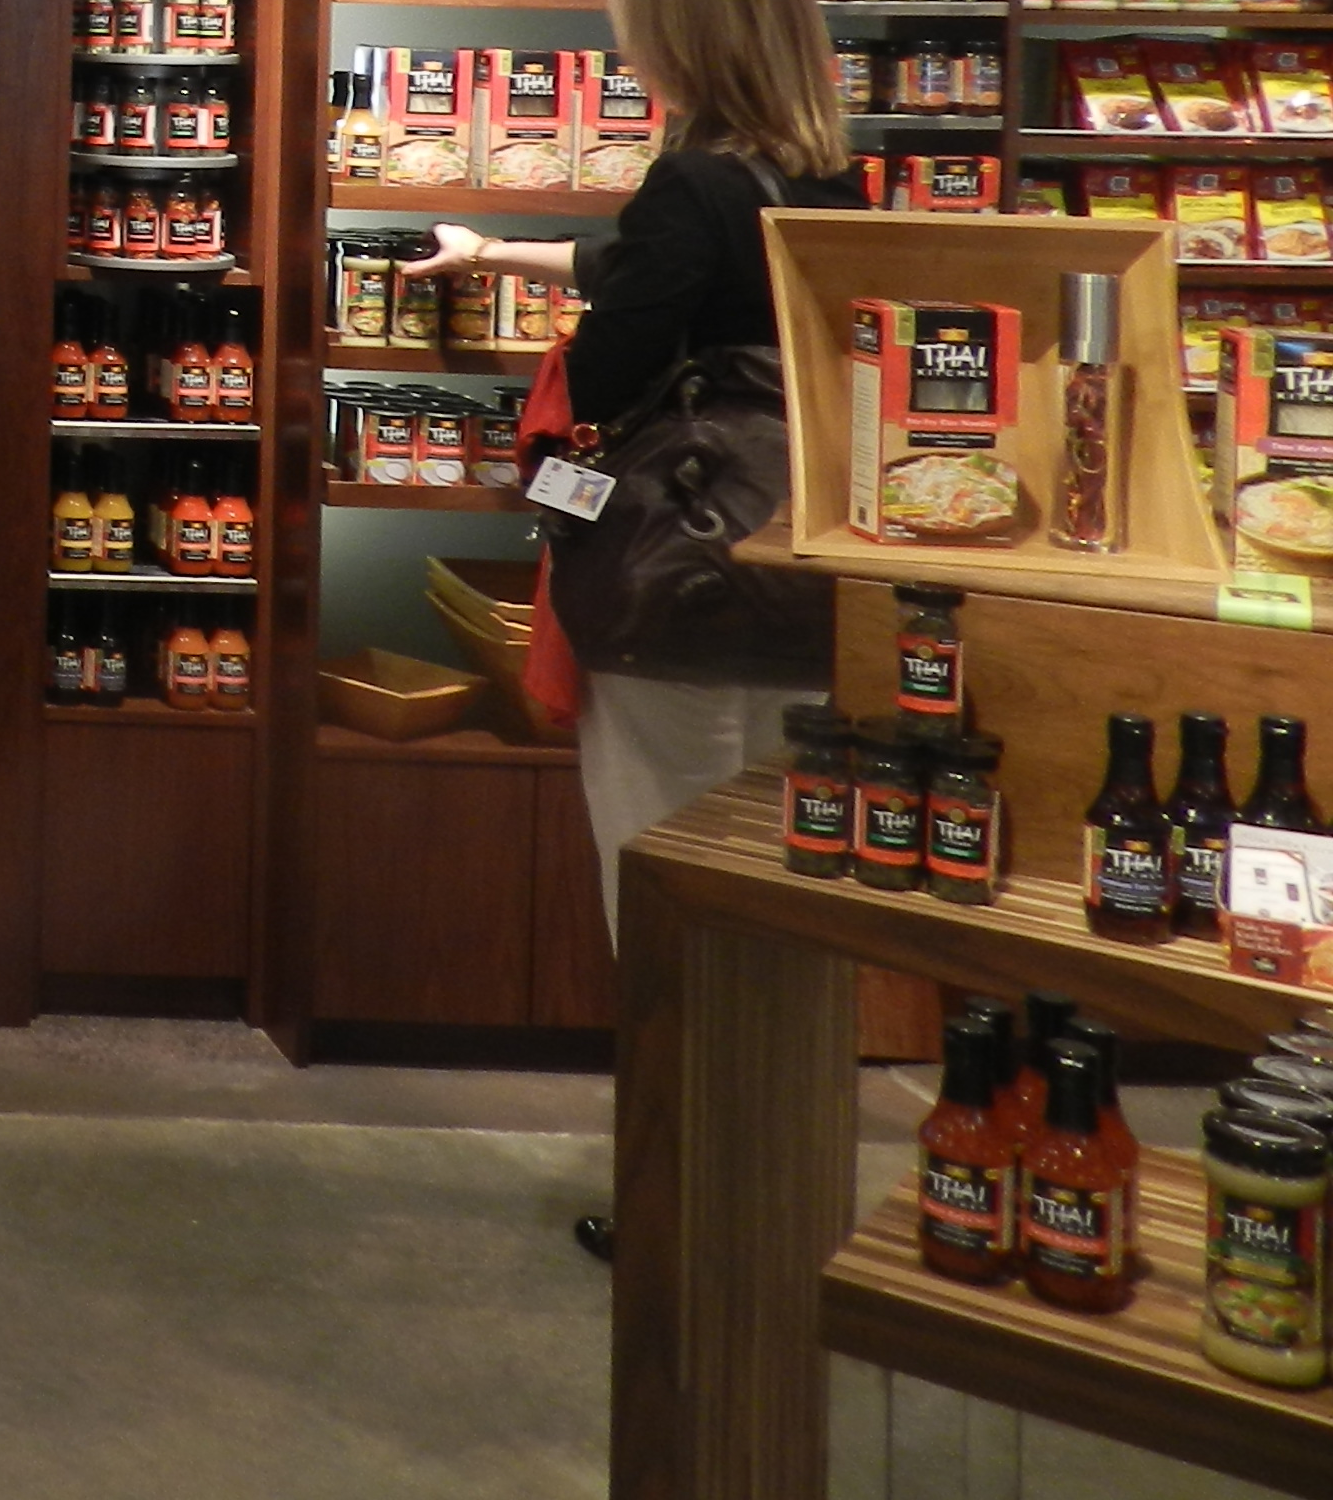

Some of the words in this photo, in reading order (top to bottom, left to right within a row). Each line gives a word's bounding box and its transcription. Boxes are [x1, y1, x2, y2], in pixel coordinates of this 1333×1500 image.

[410, 71, 453, 91] THAI
[510, 73, 553, 93] THAI
[602, 75, 641, 94] THA
[934, 175, 977, 193] THAI
[917, 343, 986, 372] THAI
[904, 657, 949, 678] THAI
[801, 798, 844, 817] THAI
[872, 810, 916, 830] THAI
[936, 820, 981, 842] THAI
[1105, 849, 1162, 874] THAI
[1184, 848, 1220, 872] TH
[928, 1170, 985, 1201] THAI
[1033, 1194, 1093, 1227] THAI
[1227, 1212, 1289, 1244] THAI
